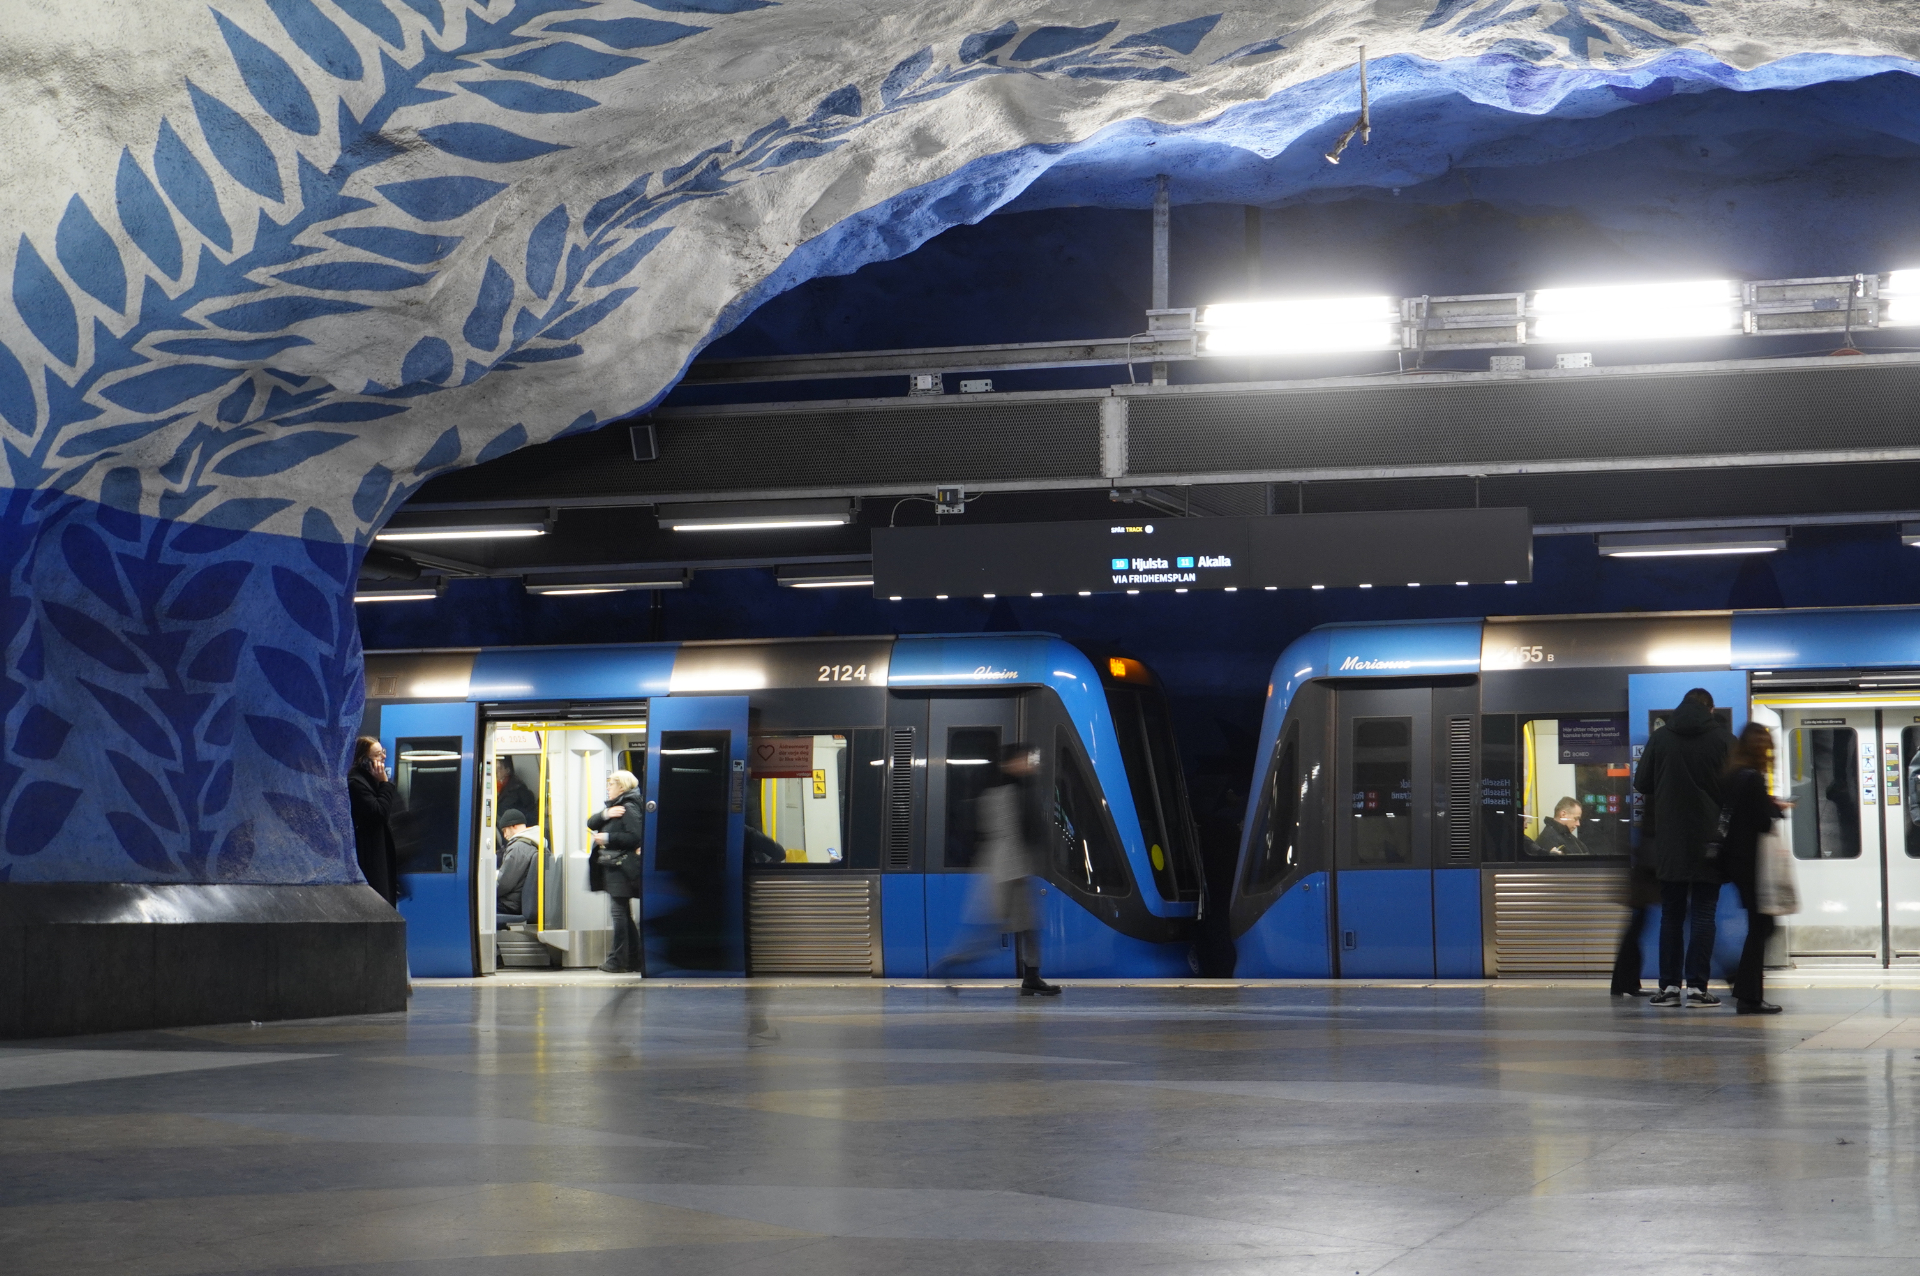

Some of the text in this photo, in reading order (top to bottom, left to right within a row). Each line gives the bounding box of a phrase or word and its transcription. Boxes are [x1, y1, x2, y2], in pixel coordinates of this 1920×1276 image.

[1131, 558, 1169, 571] Hjulsta
[1198, 555, 1231, 567] Akalla
[1112, 573, 1196, 583] VIA FRIDHEMSPLAN
[1547, 654, 1554, 662] B
[818, 665, 867, 681] 2124
